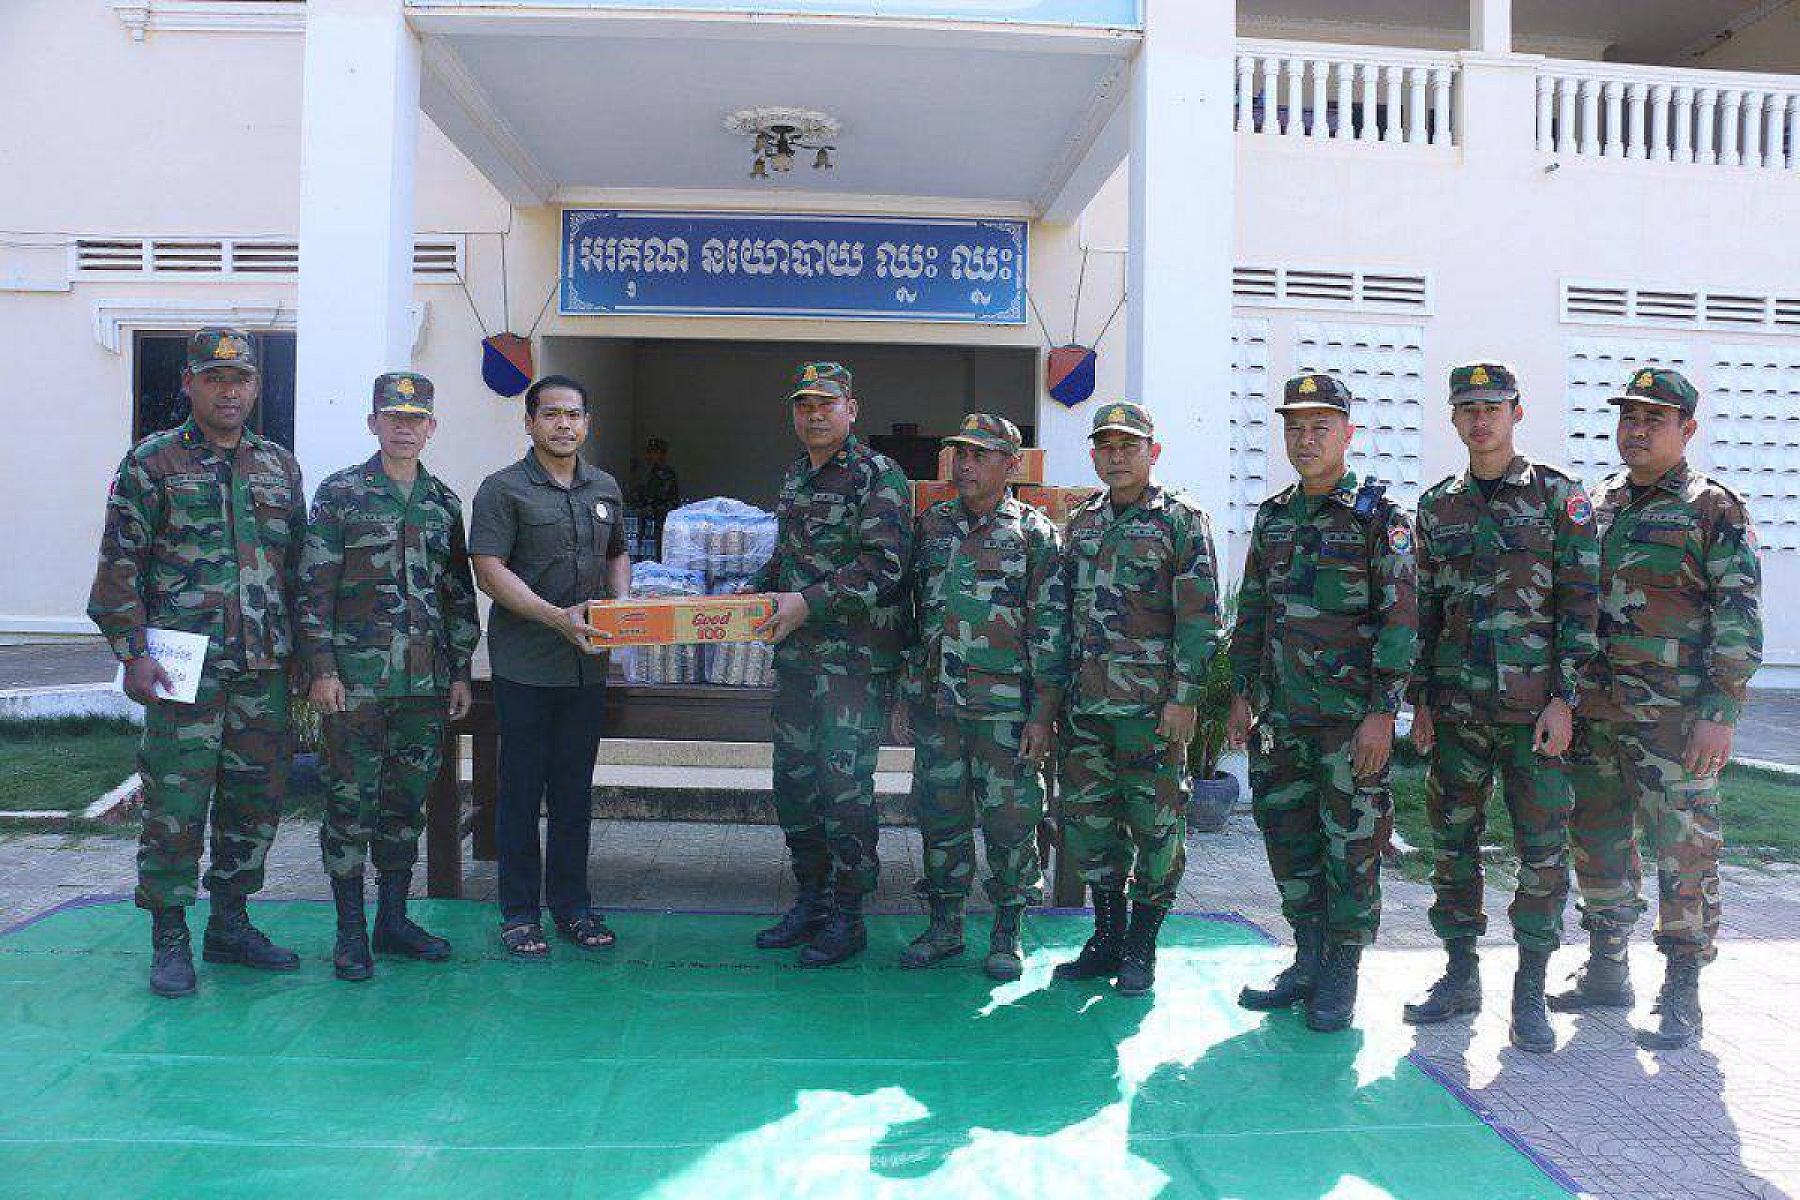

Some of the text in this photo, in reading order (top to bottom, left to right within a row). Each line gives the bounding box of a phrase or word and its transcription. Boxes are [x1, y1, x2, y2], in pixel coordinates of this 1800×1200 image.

[581, 236, 1012, 305] អរគុណ នយោបាយ ឈ្នះ ឈ្នះ
[692, 611, 732, 627] Good
